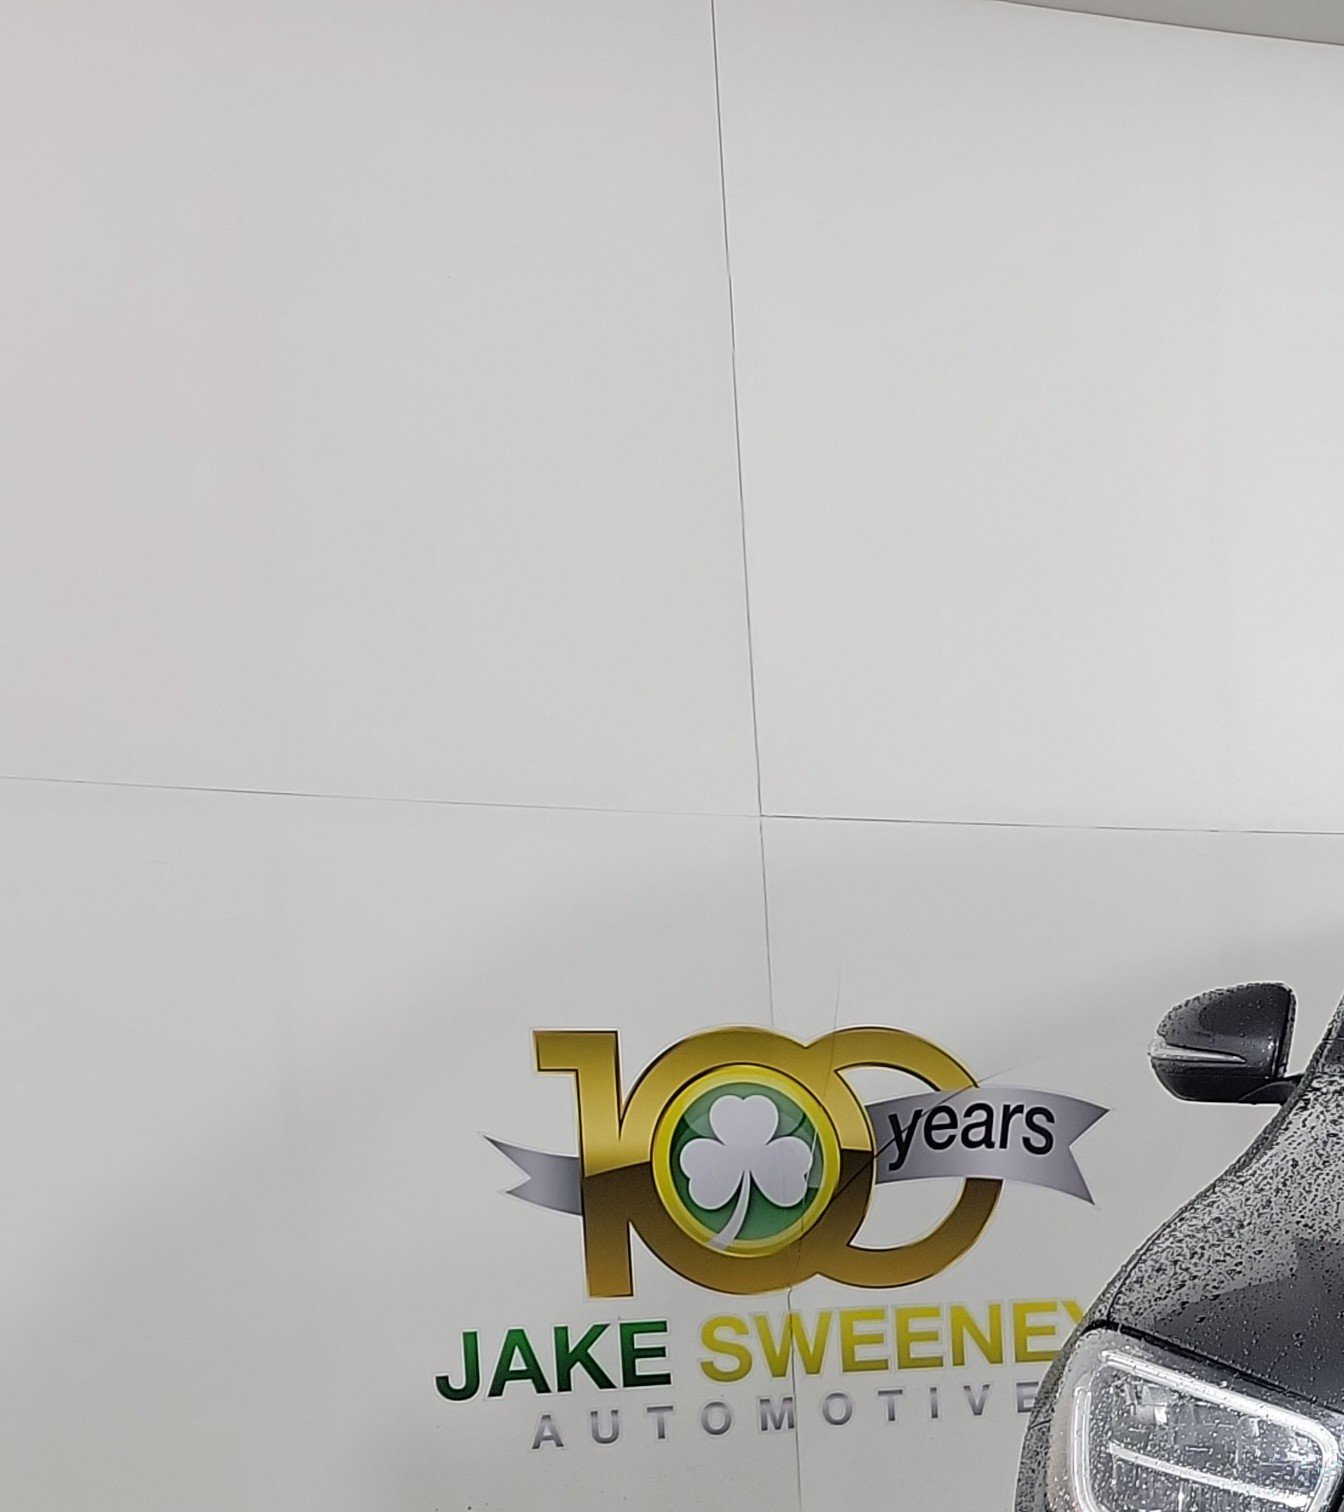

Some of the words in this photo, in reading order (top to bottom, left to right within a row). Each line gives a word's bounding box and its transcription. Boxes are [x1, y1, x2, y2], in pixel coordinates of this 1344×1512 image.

[533, 1025, 1002, 1296] 100
[888, 1102, 1056, 1170] years
[435, 1320, 671, 1401] JAKE
[700, 1300, 1085, 1383] SWEENE
[532, 1381, 1039, 1449] AUTOMOTIVE
